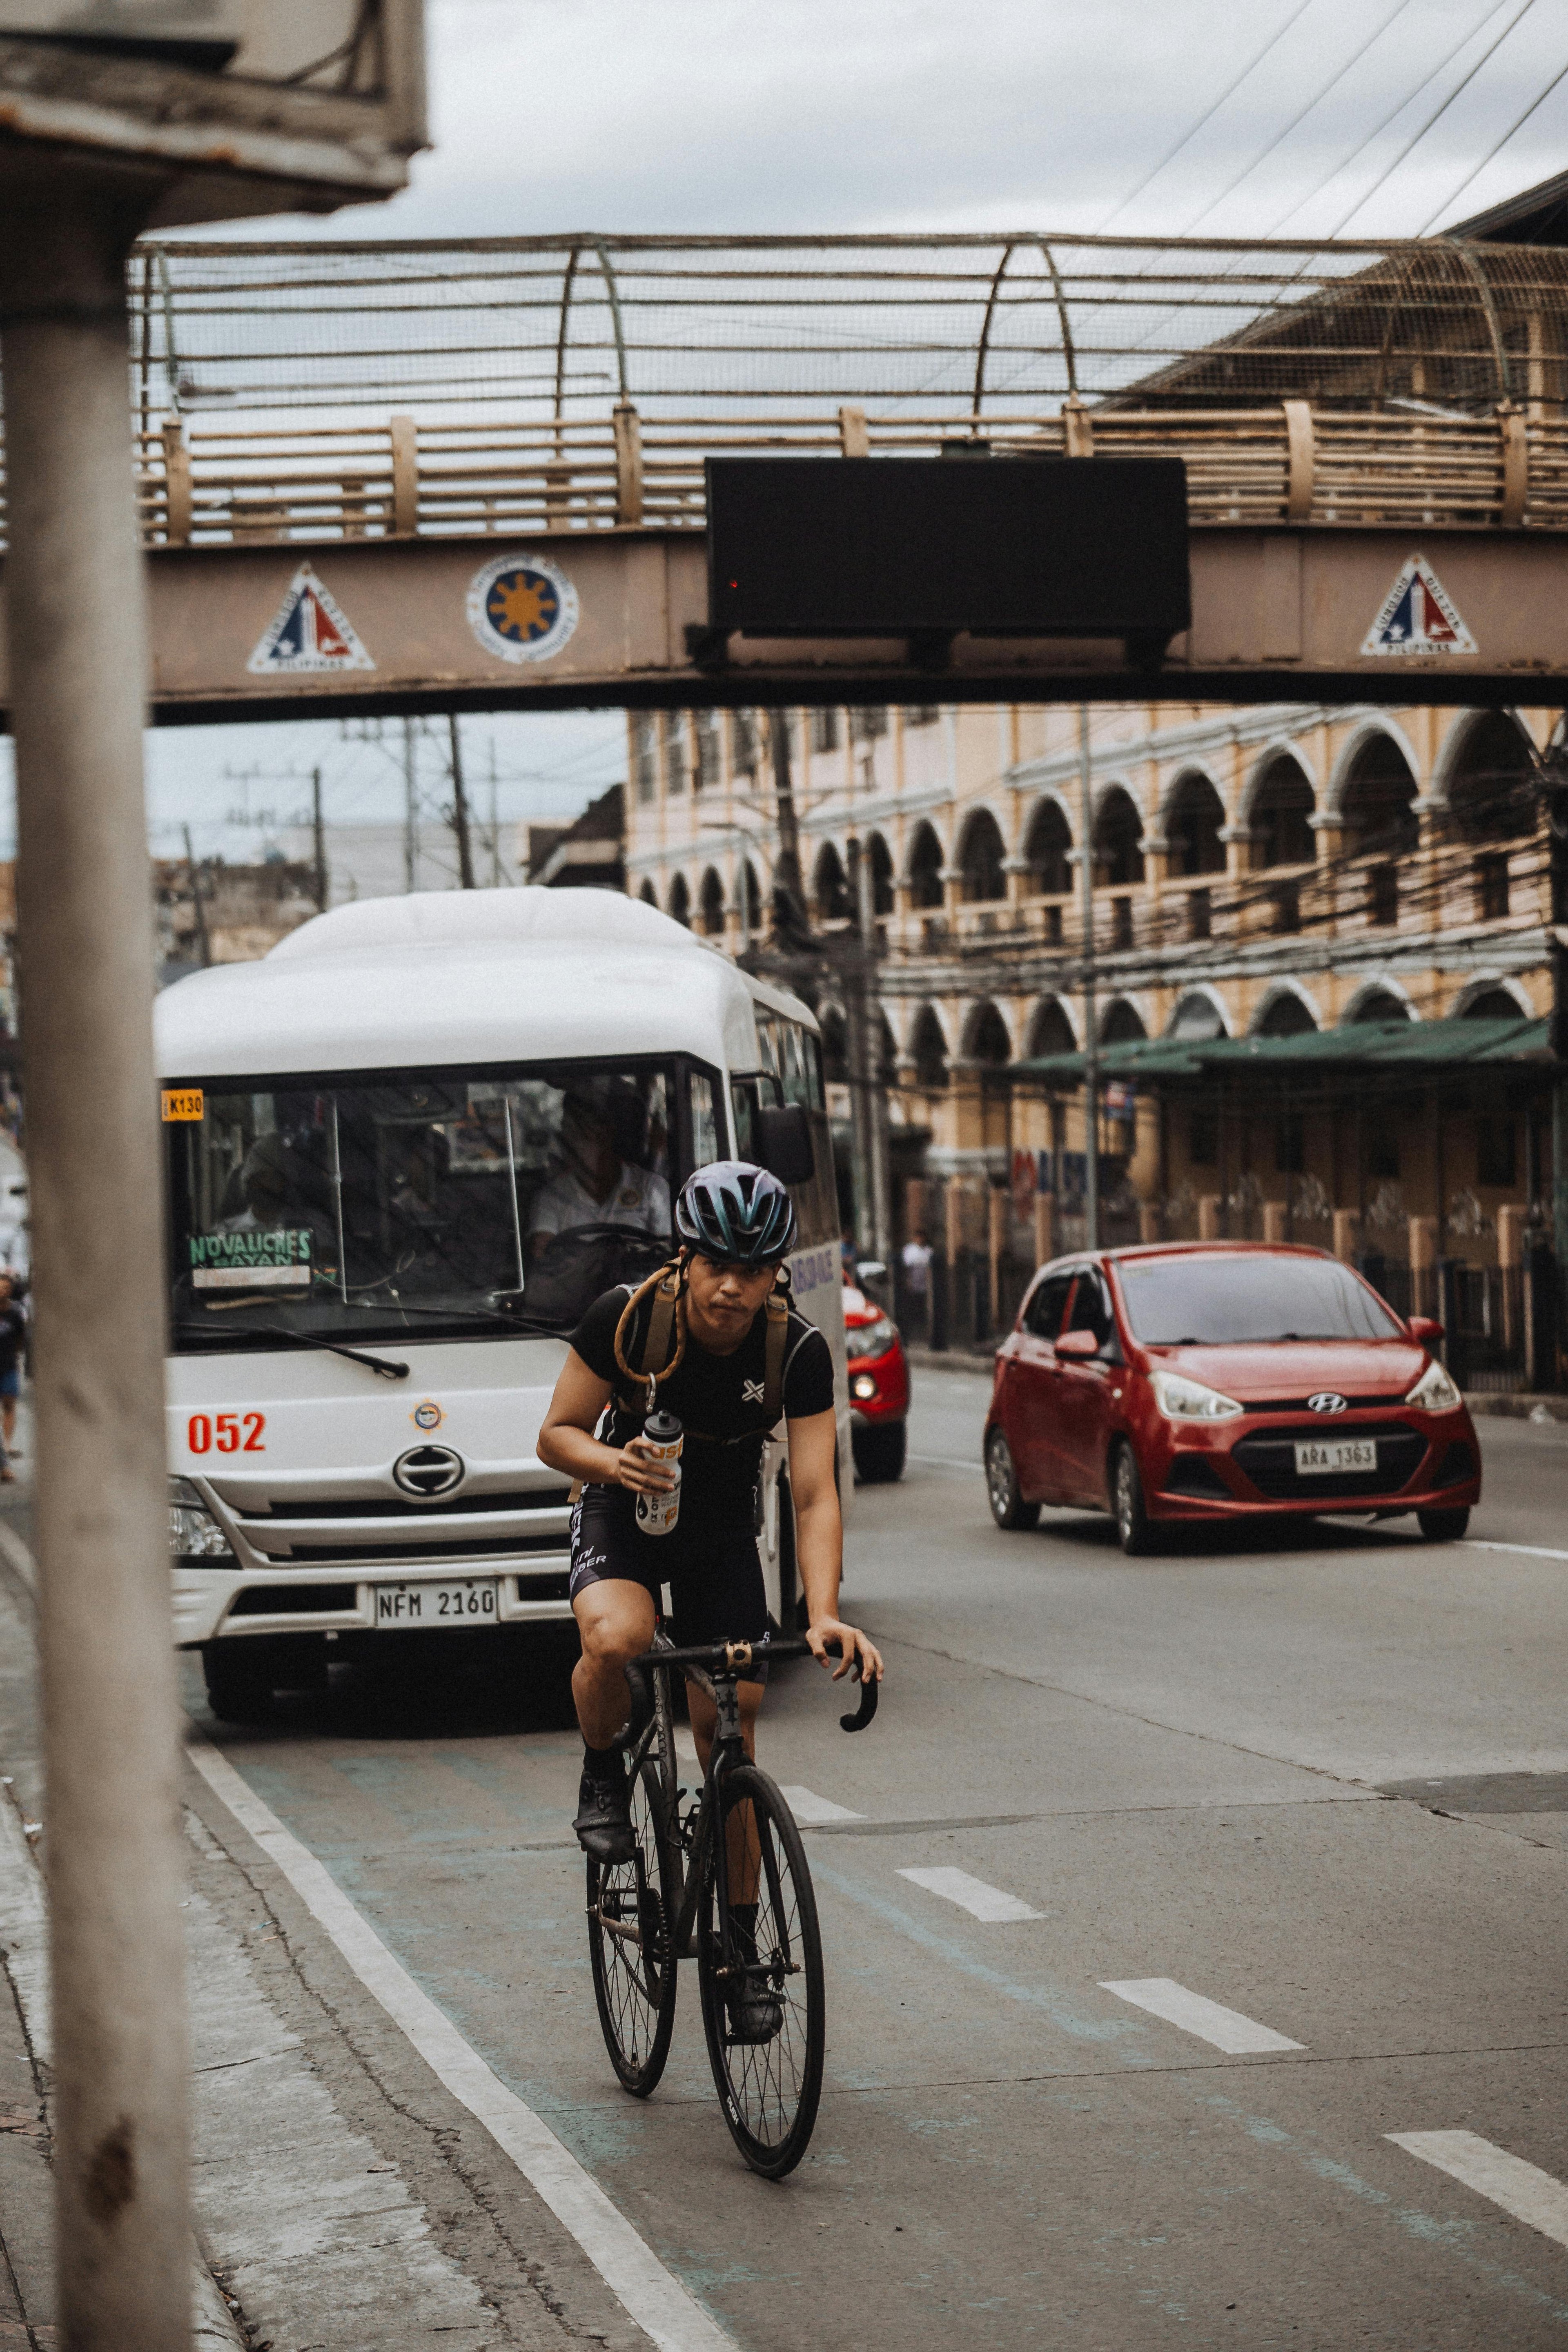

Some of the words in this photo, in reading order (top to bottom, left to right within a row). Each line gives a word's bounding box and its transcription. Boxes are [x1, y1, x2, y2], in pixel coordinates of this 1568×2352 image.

[189, 1412, 267, 1454] 052
[1301, 1448, 1328, 1465] ARA
[1336, 1446, 1372, 1464] 1363
[380, 1593, 421, 1617] NFM
[438, 1590, 494, 1615] 2160
